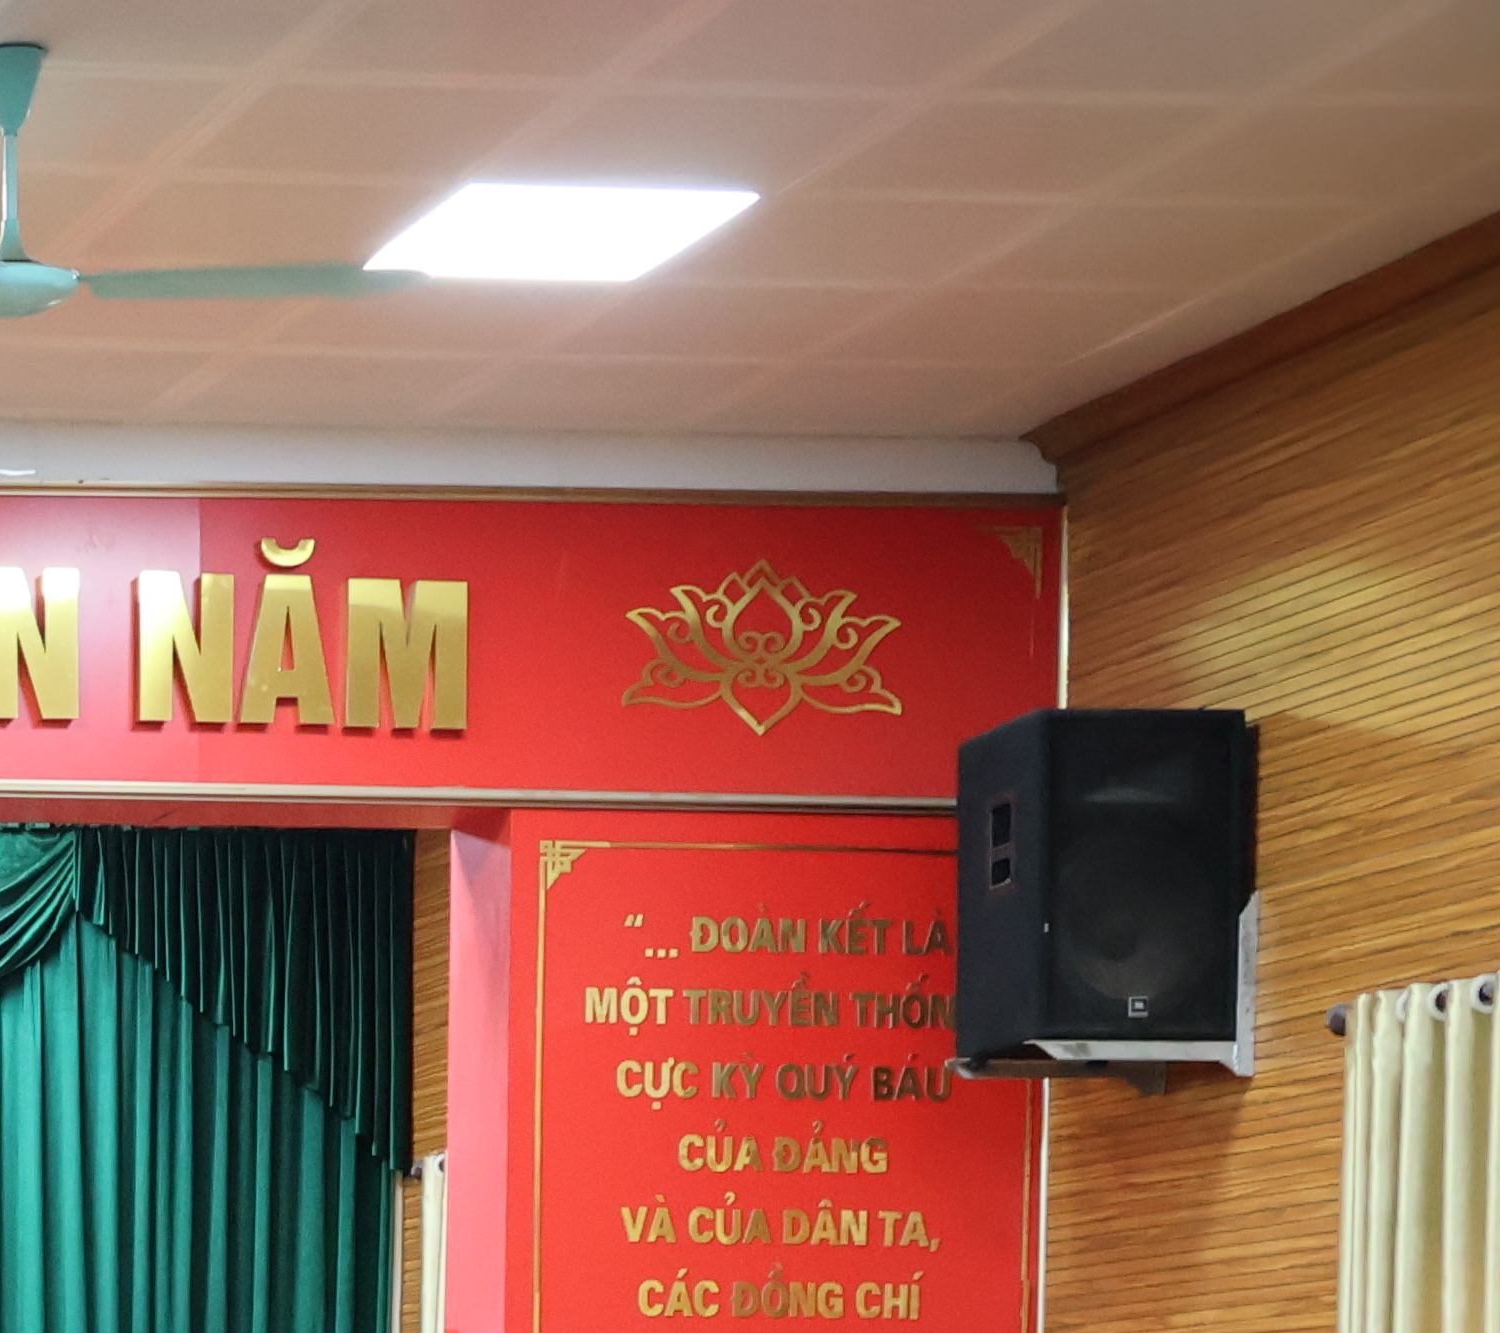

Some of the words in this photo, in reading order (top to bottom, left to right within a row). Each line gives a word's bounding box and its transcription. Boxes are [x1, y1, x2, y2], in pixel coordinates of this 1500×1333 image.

[135, 537, 469, 730] NĂM
[690, 903, 805, 952] ĐOÀN
[819, 901, 890, 953] KẾT
[902, 907, 951, 955] LÀ
[585, 976, 674, 1035] MỘT
[683, 971, 837, 1025] TRUYỀN
[850, 973, 956, 1029] THỐN
[616, 1057, 698, 1109] CỰC
[712, 1051, 764, 1097] KỲ
[777, 1053, 858, 1100] QUÝ
[871, 1053, 952, 1100] BÁU
[678, 1121, 761, 1172] CỦA
[773, 1121, 887, 1173] ĐẢNG
[621, 1195, 676, 1242] VÀ
[689, 1192, 770, 1245] CỦA
[784, 1200, 867, 1245] DÂN
[879, 1211, 939, 1251] TA,
[638, 1268, 719, 1317] CÁC
[731, 1262, 843, 1318] ĐỒNG
[856, 1270, 923, 1319] CHÍ
